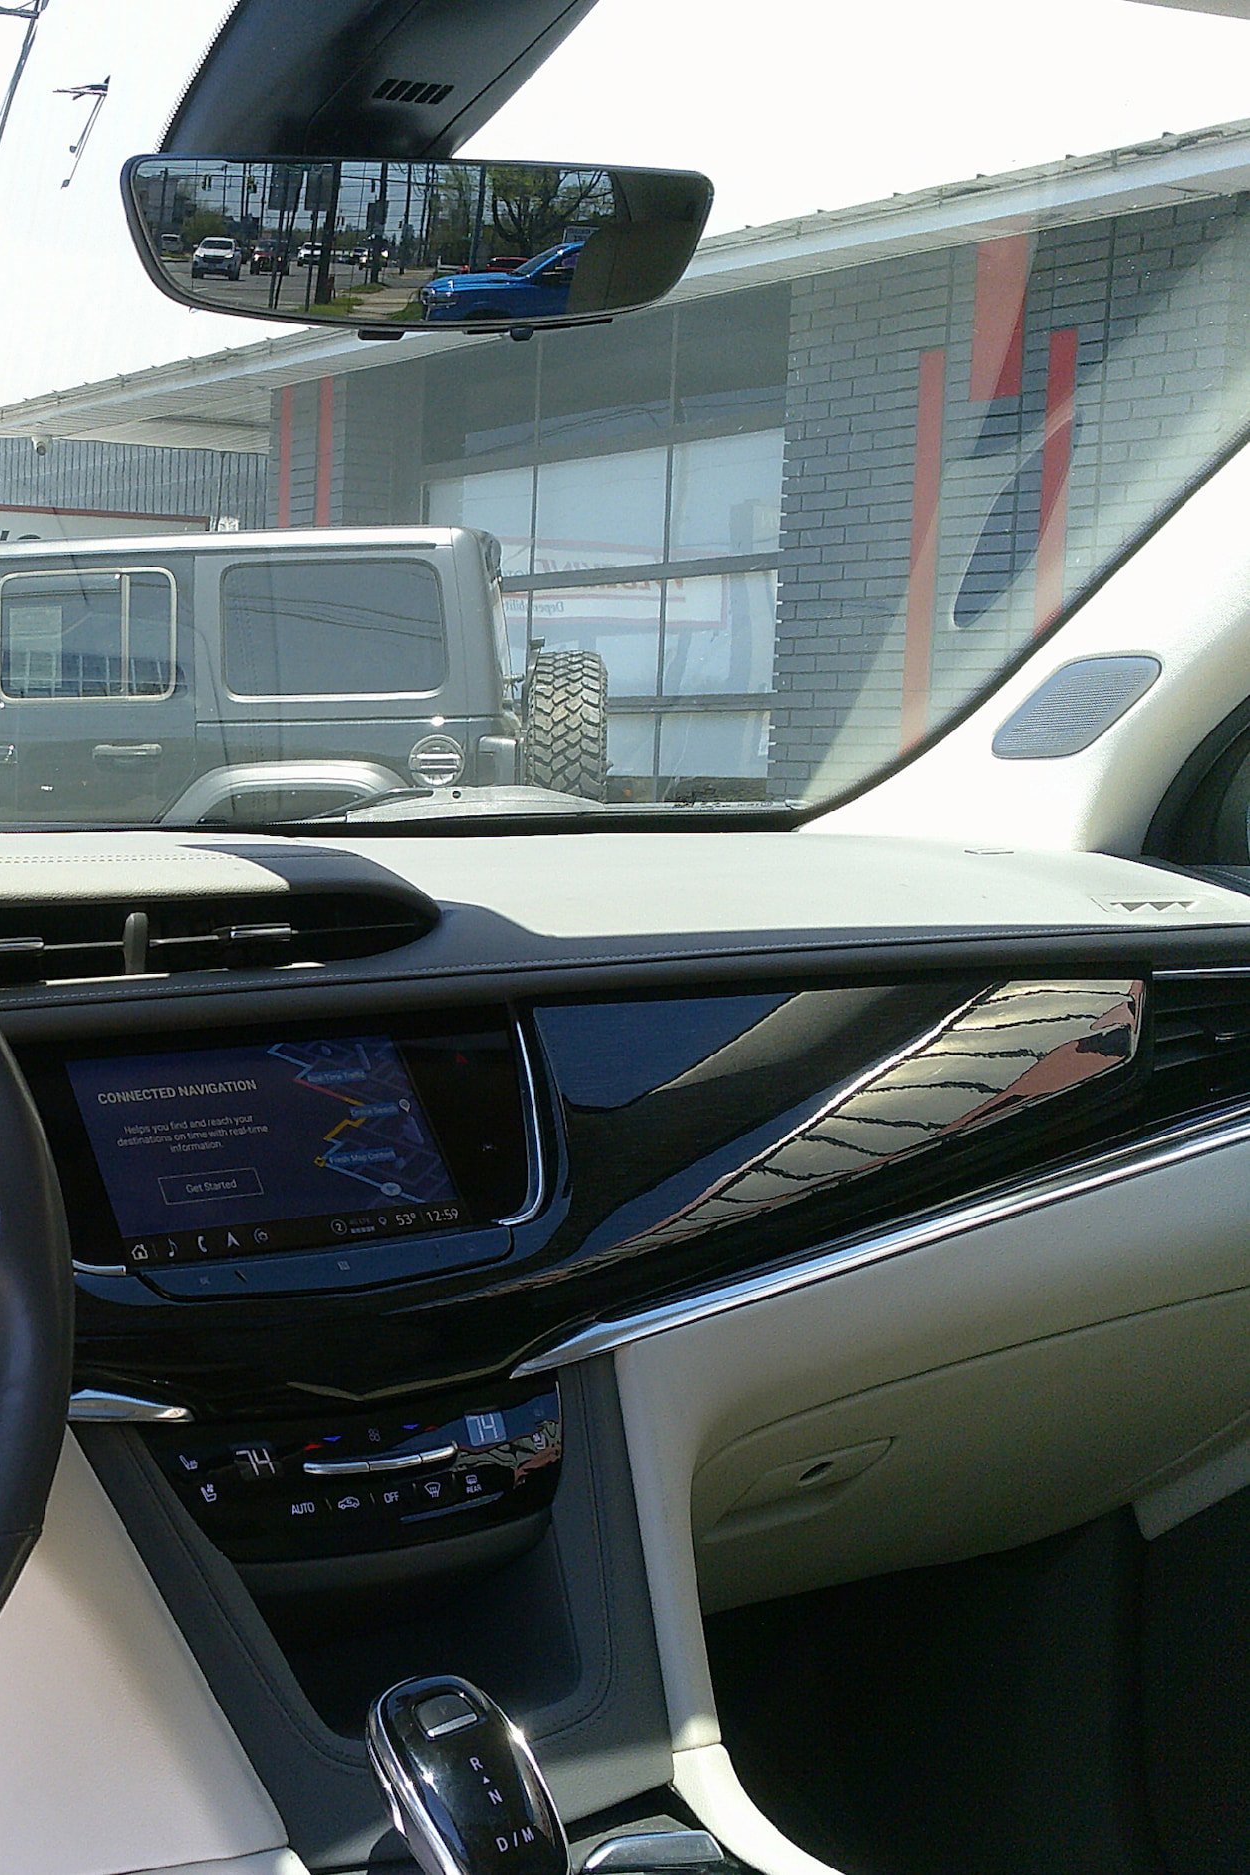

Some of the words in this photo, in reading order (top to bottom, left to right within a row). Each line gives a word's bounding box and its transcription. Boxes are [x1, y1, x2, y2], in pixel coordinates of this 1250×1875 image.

[97, 1086, 177, 1105] CONNECTED
[178, 1079, 258, 1098] NAVIGATION
[124, 1124, 151, 1136] Helps
[152, 1123, 169, 1134] you
[170, 1120, 188, 1131] find
[189, 1118, 207, 1129] and
[207, 1116, 233, 1128] reach
[233, 1114, 254, 1126] your
[116, 1133, 172, 1147] destinations
[174, 1133, 186, 1141] on
[187, 1130, 207, 1141] time
[207, 1128, 228, 1139] with
[229, 1125, 269, 1137] real-time
[185, 1182, 203, 1194] Get
[204, 1178, 237, 1193] Started
[395, 1212, 417, 1226] 53°
[426, 1207, 459, 1223] 12:59
[235, 1447, 277, 1477] 74
[383, 1490, 400, 1504] OFF
[291, 1501, 316, 1516] AUTO
[468, 1756, 484, 1772] R
[487, 1787, 504, 1806] N
